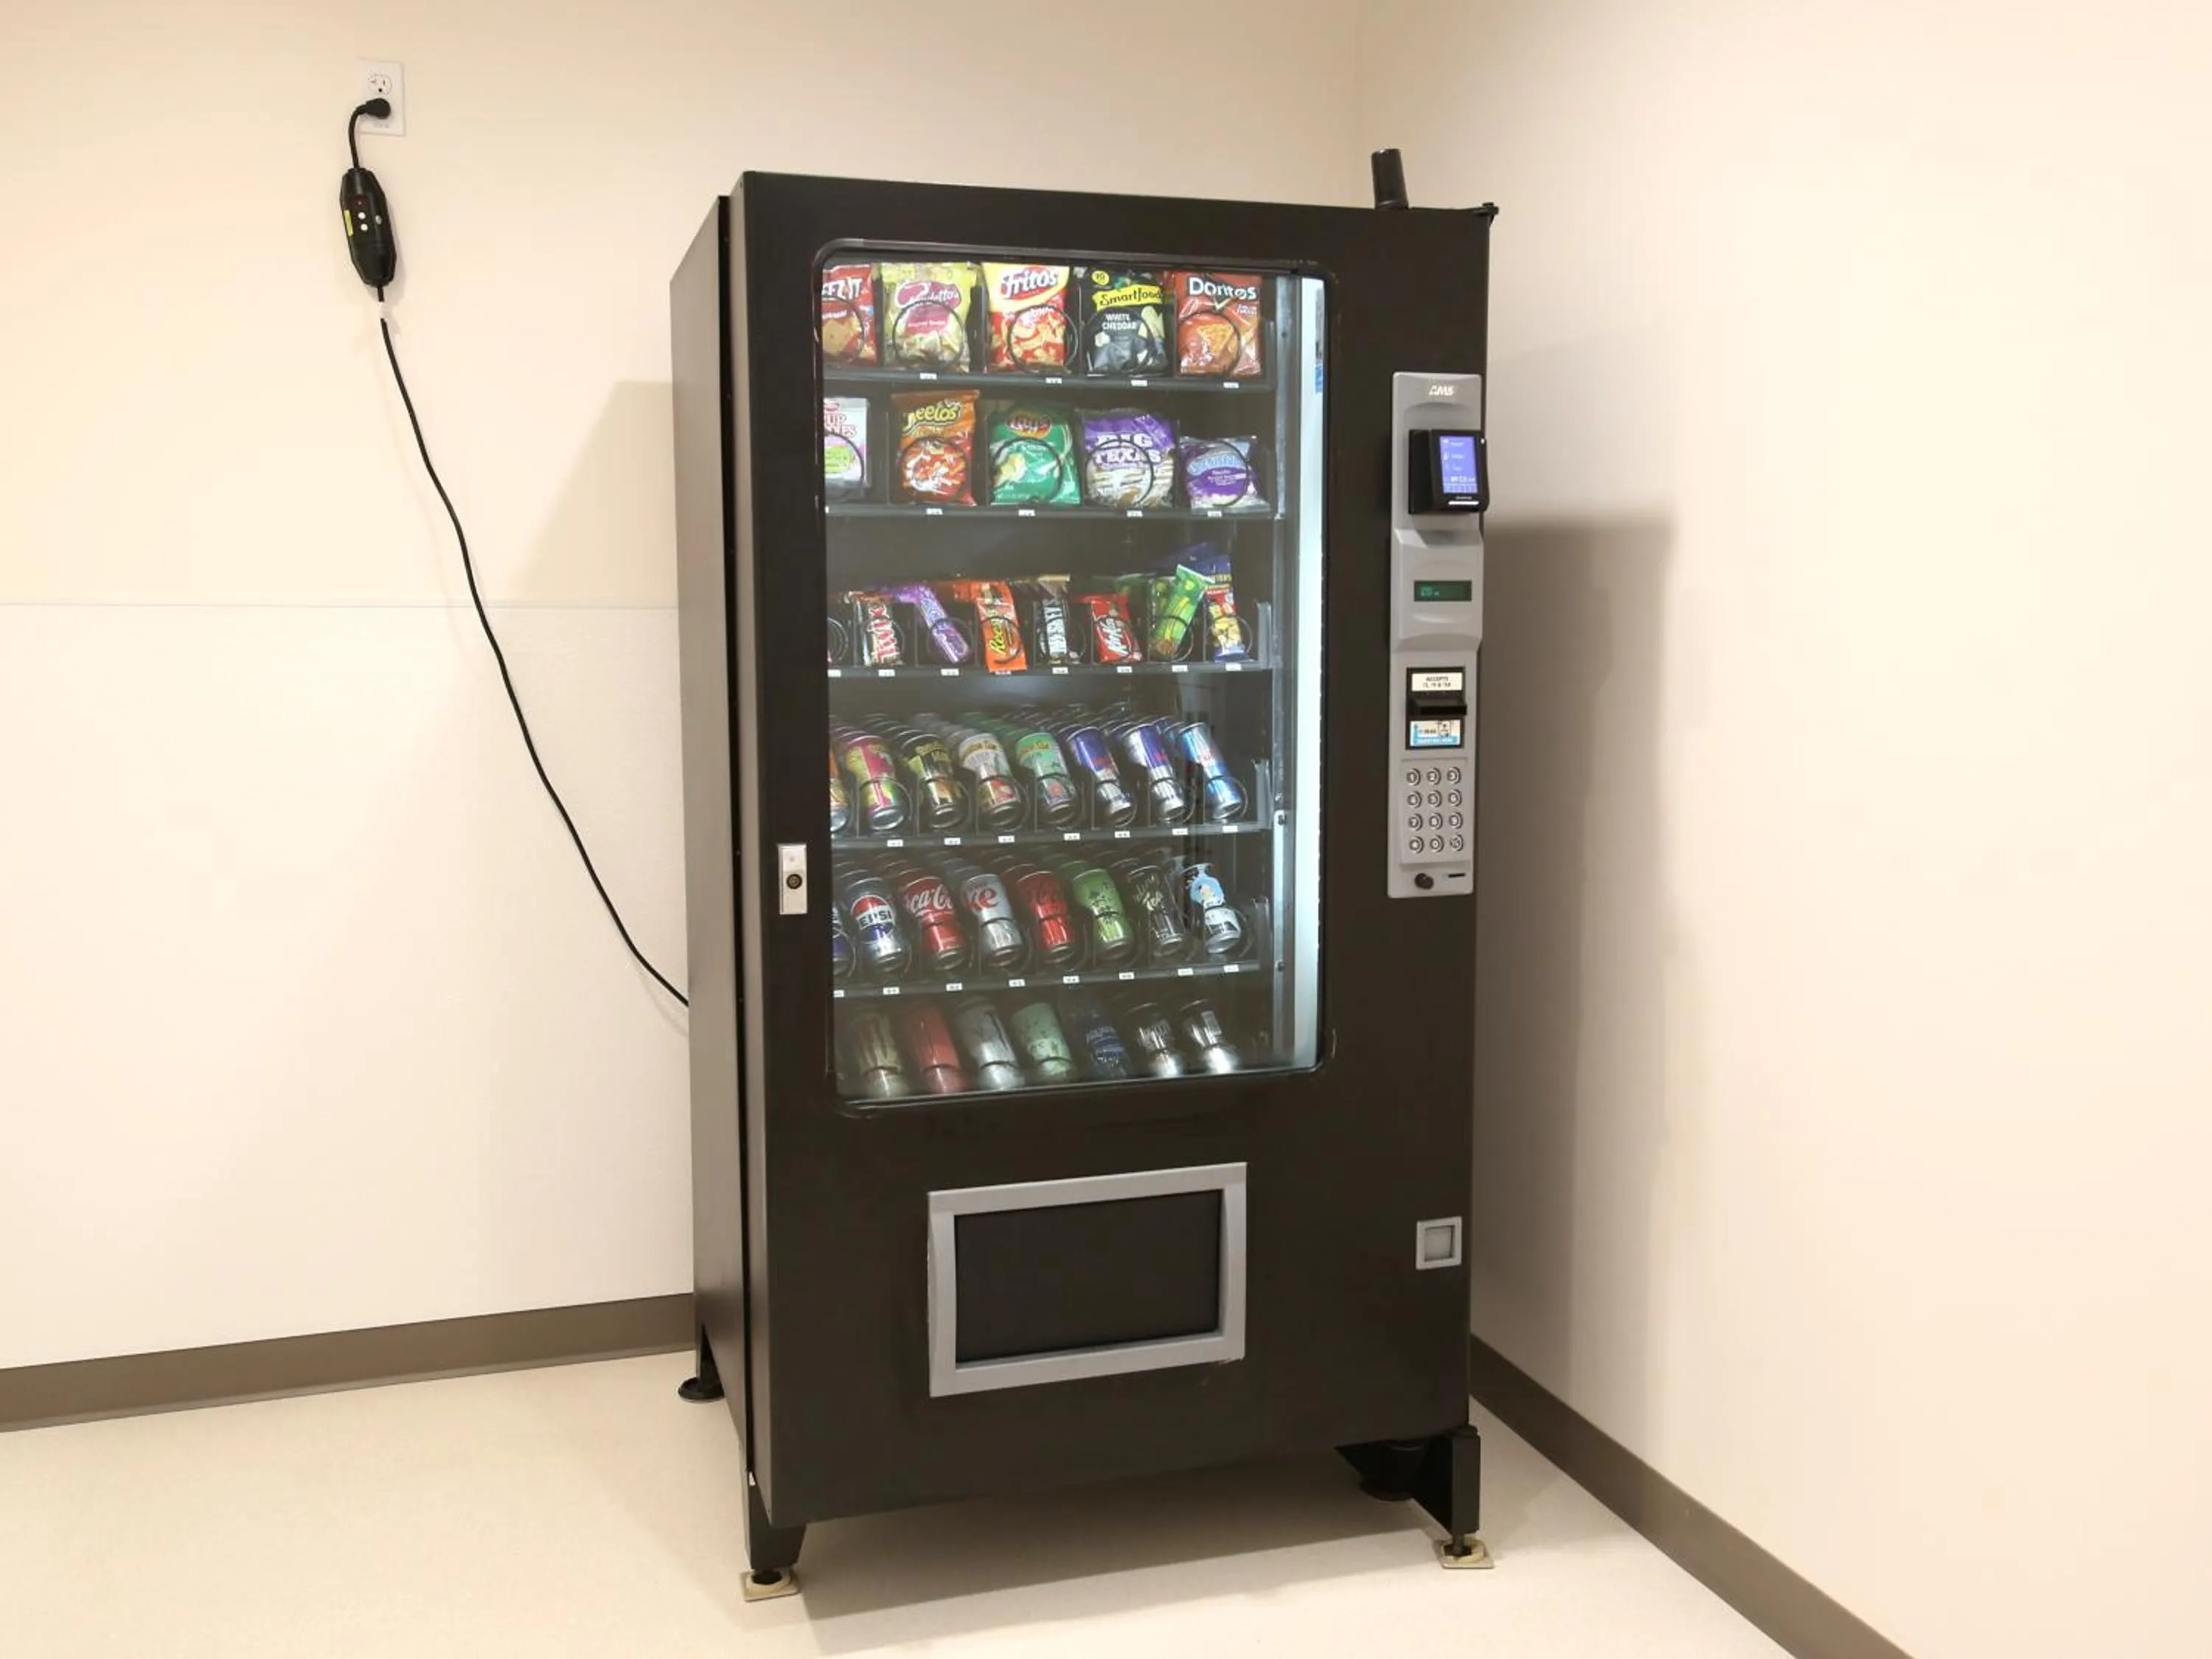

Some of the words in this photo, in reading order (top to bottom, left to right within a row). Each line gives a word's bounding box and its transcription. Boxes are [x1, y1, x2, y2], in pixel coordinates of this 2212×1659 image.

[1002, 269, 1058, 299] Fritos
[1189, 276, 1257, 300] Doritos
[1099, 287, 1162, 306] Smartfood
[1102, 321, 1137, 330] CHEDDAR
[1105, 313, 1130, 321] WHITE
